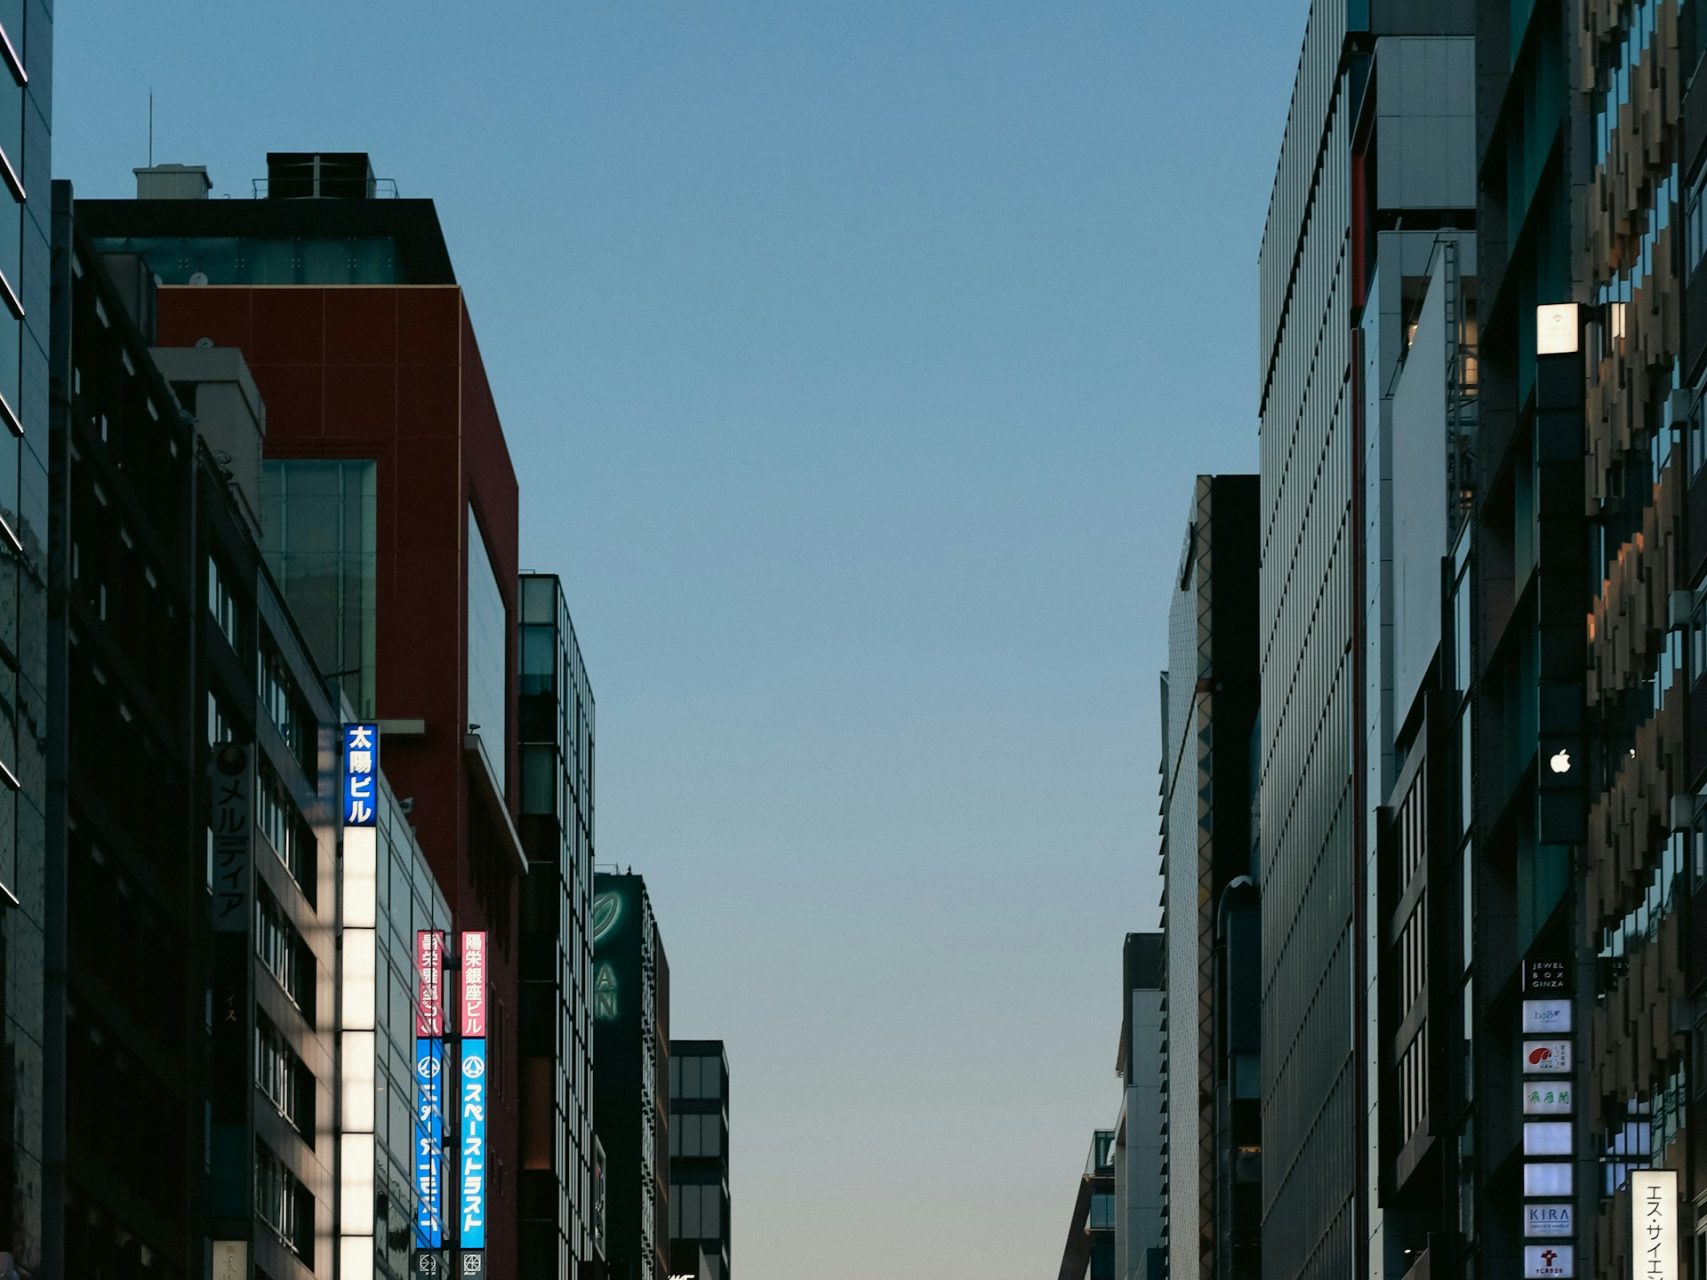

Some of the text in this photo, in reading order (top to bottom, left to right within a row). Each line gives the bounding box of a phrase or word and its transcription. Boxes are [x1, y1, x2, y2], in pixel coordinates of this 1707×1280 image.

[349, 726, 371, 824] 太陽ビル
[218, 779, 246, 917] メルディア
[465, 934, 482, 1033] 陽栄銀座ビル
[1532, 962, 1564, 970] JEWEL
[1532, 980, 1564, 988] GINZA
[464, 1084, 484, 1232] スペーストラスト
[1530, 1209, 1569, 1220] KIRA
